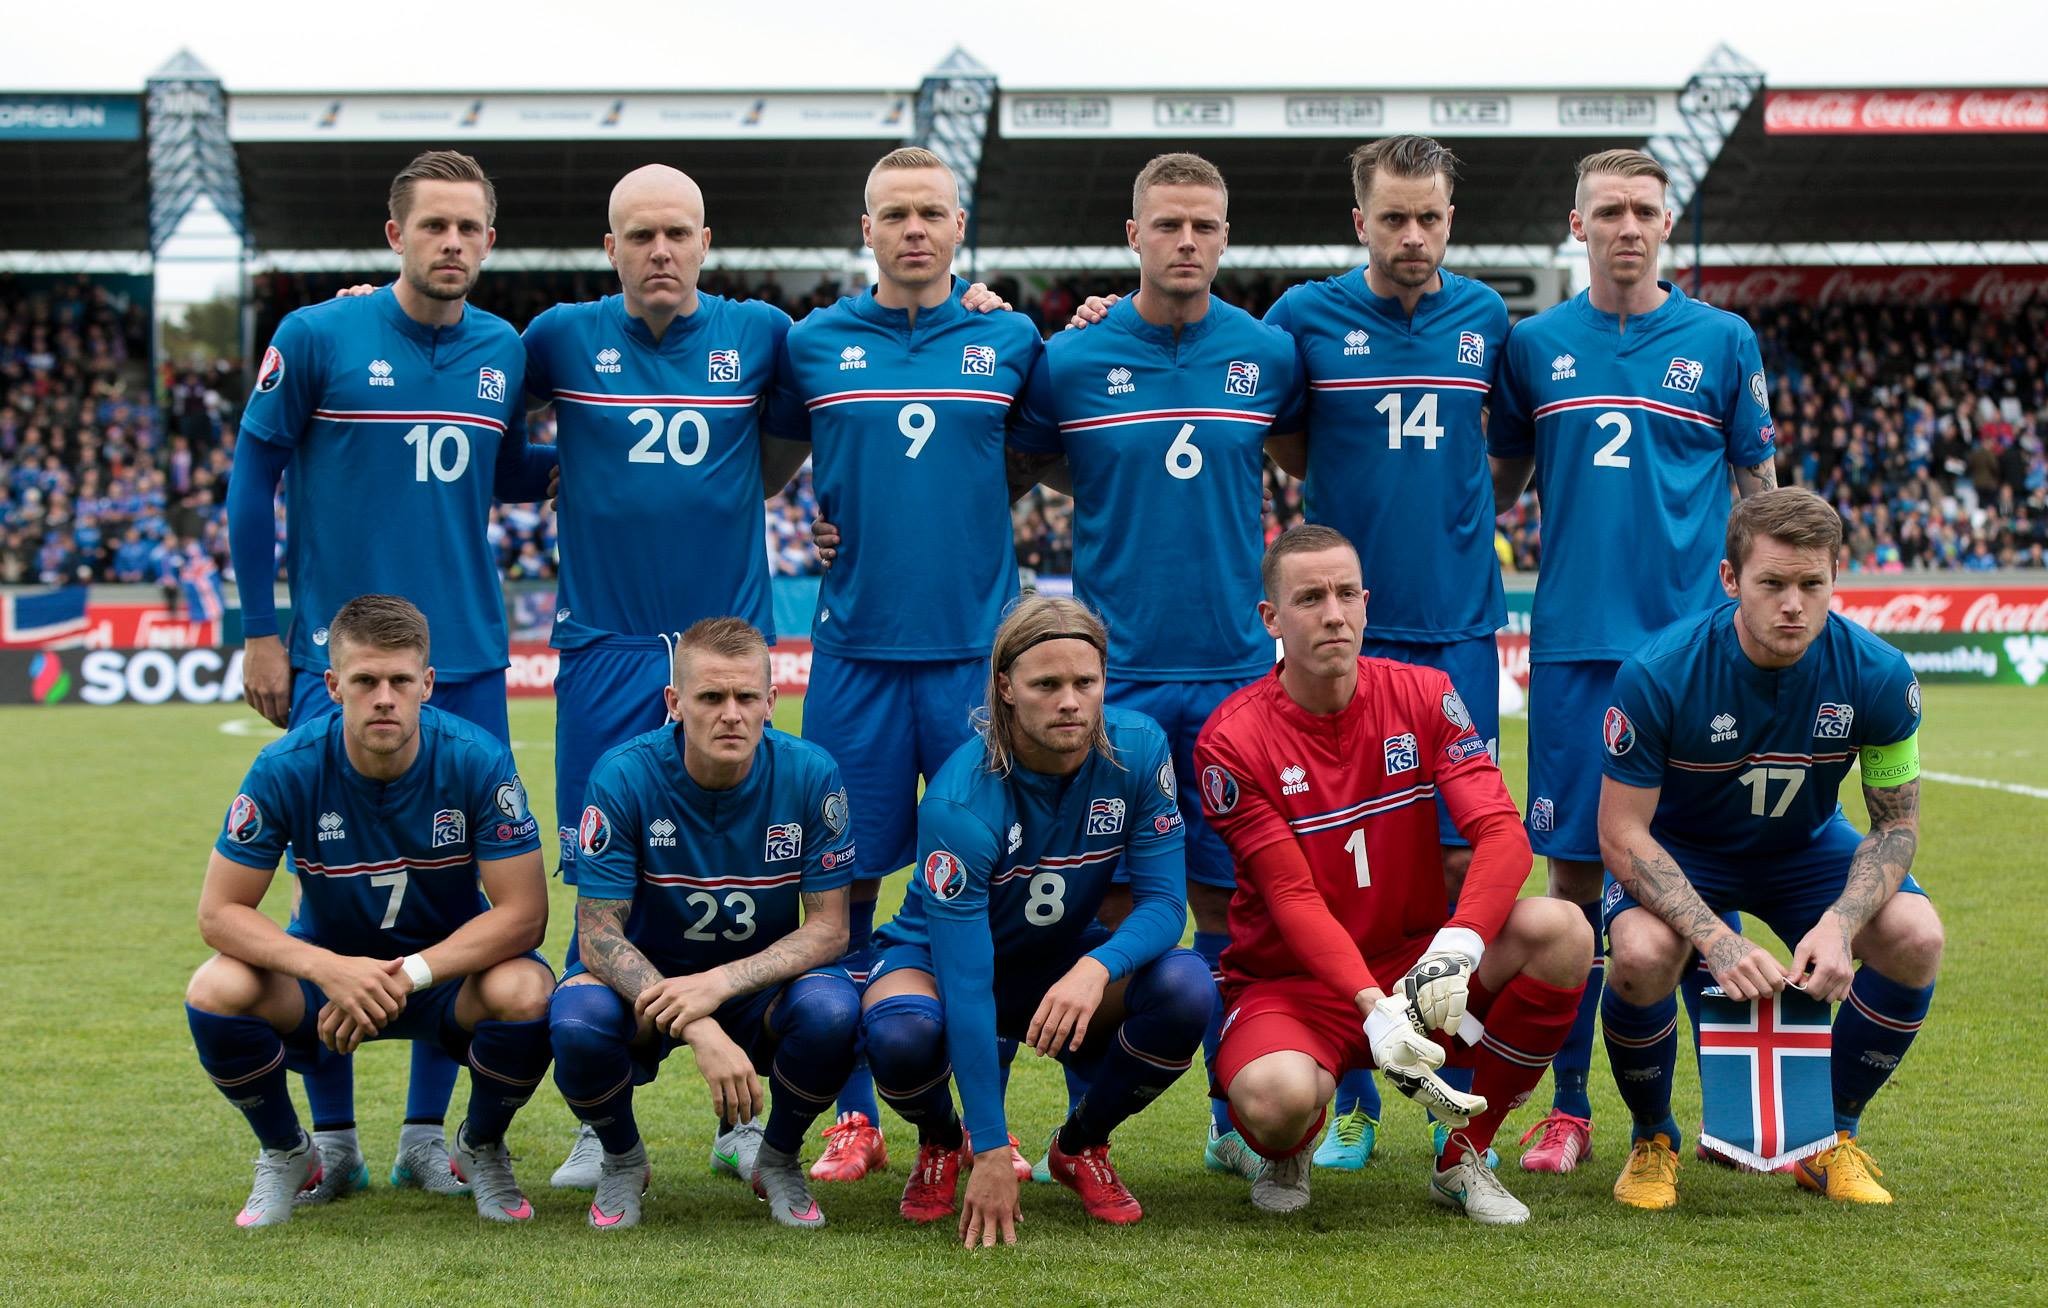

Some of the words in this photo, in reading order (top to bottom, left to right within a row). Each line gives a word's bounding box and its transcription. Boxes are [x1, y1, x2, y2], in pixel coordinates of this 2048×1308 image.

[627, 408, 710, 466] 20
[898, 403, 936, 459] 9
[1374, 393, 1444, 450] 14
[1593, 411, 1632, 469] 2
[403, 424, 470, 483] 10
[1165, 422, 1203, 480] 6
[1738, 767, 1805, 818] 17
[1873, 764, 1910, 777] RACISM
[1343, 827, 1371, 889] 1
[370, 870, 409, 930] 7
[683, 891, 757, 942] 23
[1024, 872, 1066, 926] 8
